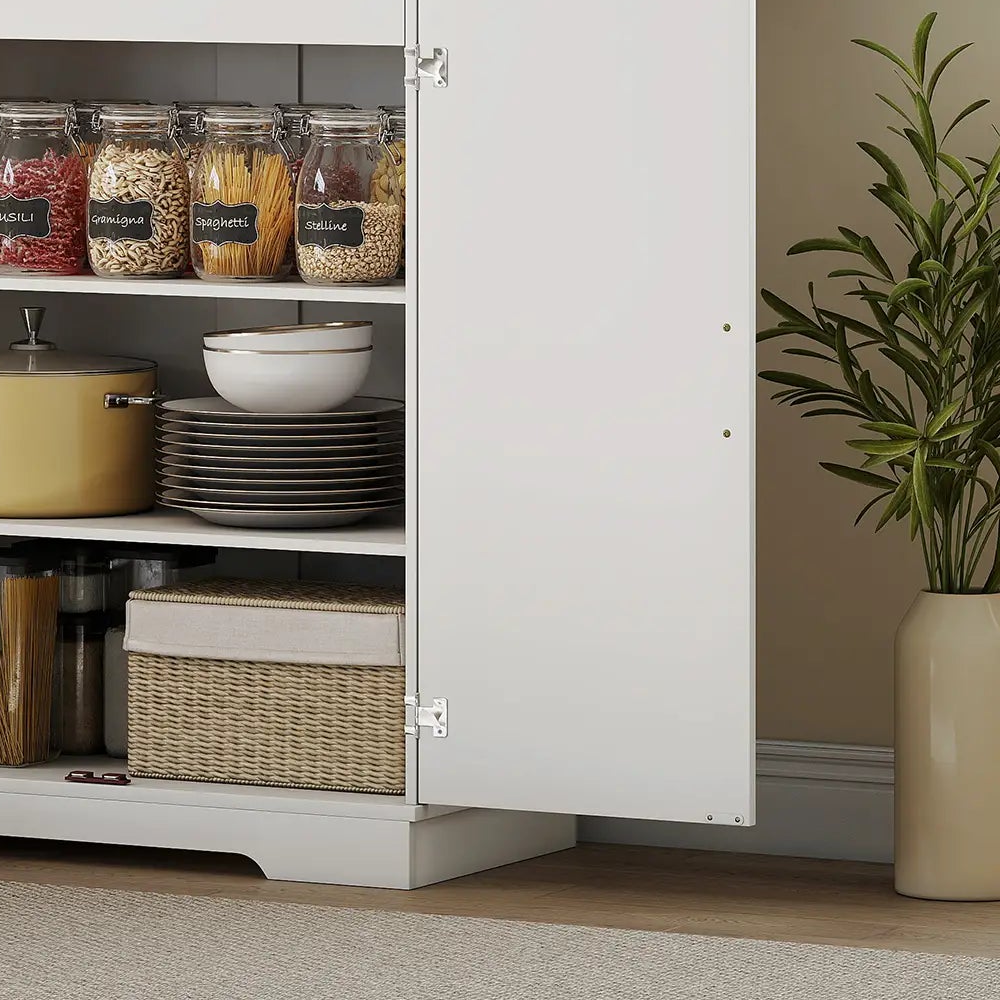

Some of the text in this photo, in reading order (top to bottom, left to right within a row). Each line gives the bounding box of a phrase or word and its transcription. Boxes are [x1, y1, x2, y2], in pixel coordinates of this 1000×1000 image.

[90, 213, 145, 227] Gramigna
[194, 214, 250, 233] Spaghetti
[304, 219, 348, 232] Stelline
